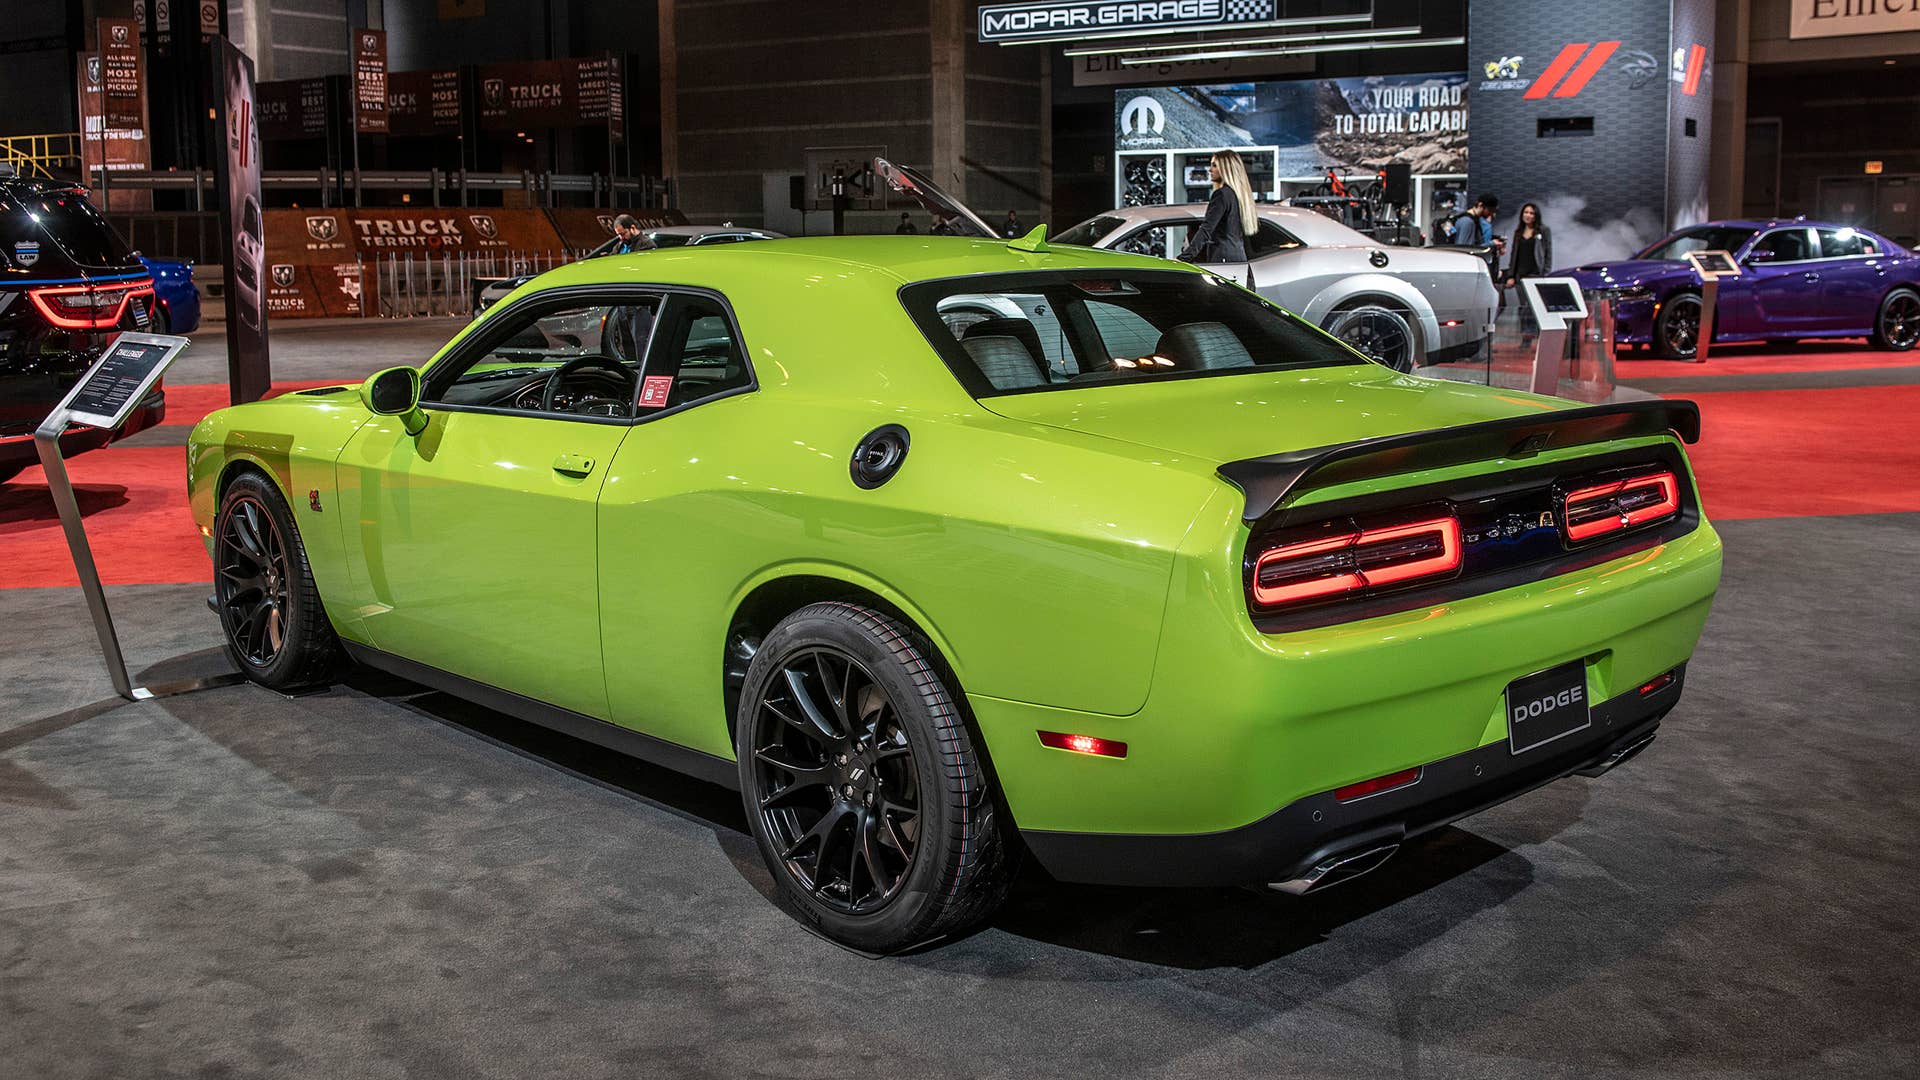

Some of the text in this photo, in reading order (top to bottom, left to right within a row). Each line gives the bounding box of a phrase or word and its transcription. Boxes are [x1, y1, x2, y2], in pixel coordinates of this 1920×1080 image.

[106, 69, 137, 78] MOST
[358, 71, 385, 80] BEST
[107, 83, 138, 91] PICKUP
[509, 83, 562, 99] TRUCK
[1371, 85, 1461, 109] YOUR ROAD
[1335, 110, 1467, 135] TO TOTAL CAPABI
[354, 218, 461, 236] TRUCK
[361, 235, 463, 248] TERRITORY
[266, 298, 305, 306] TRUCK
[1514, 685, 1583, 723] DODGE
